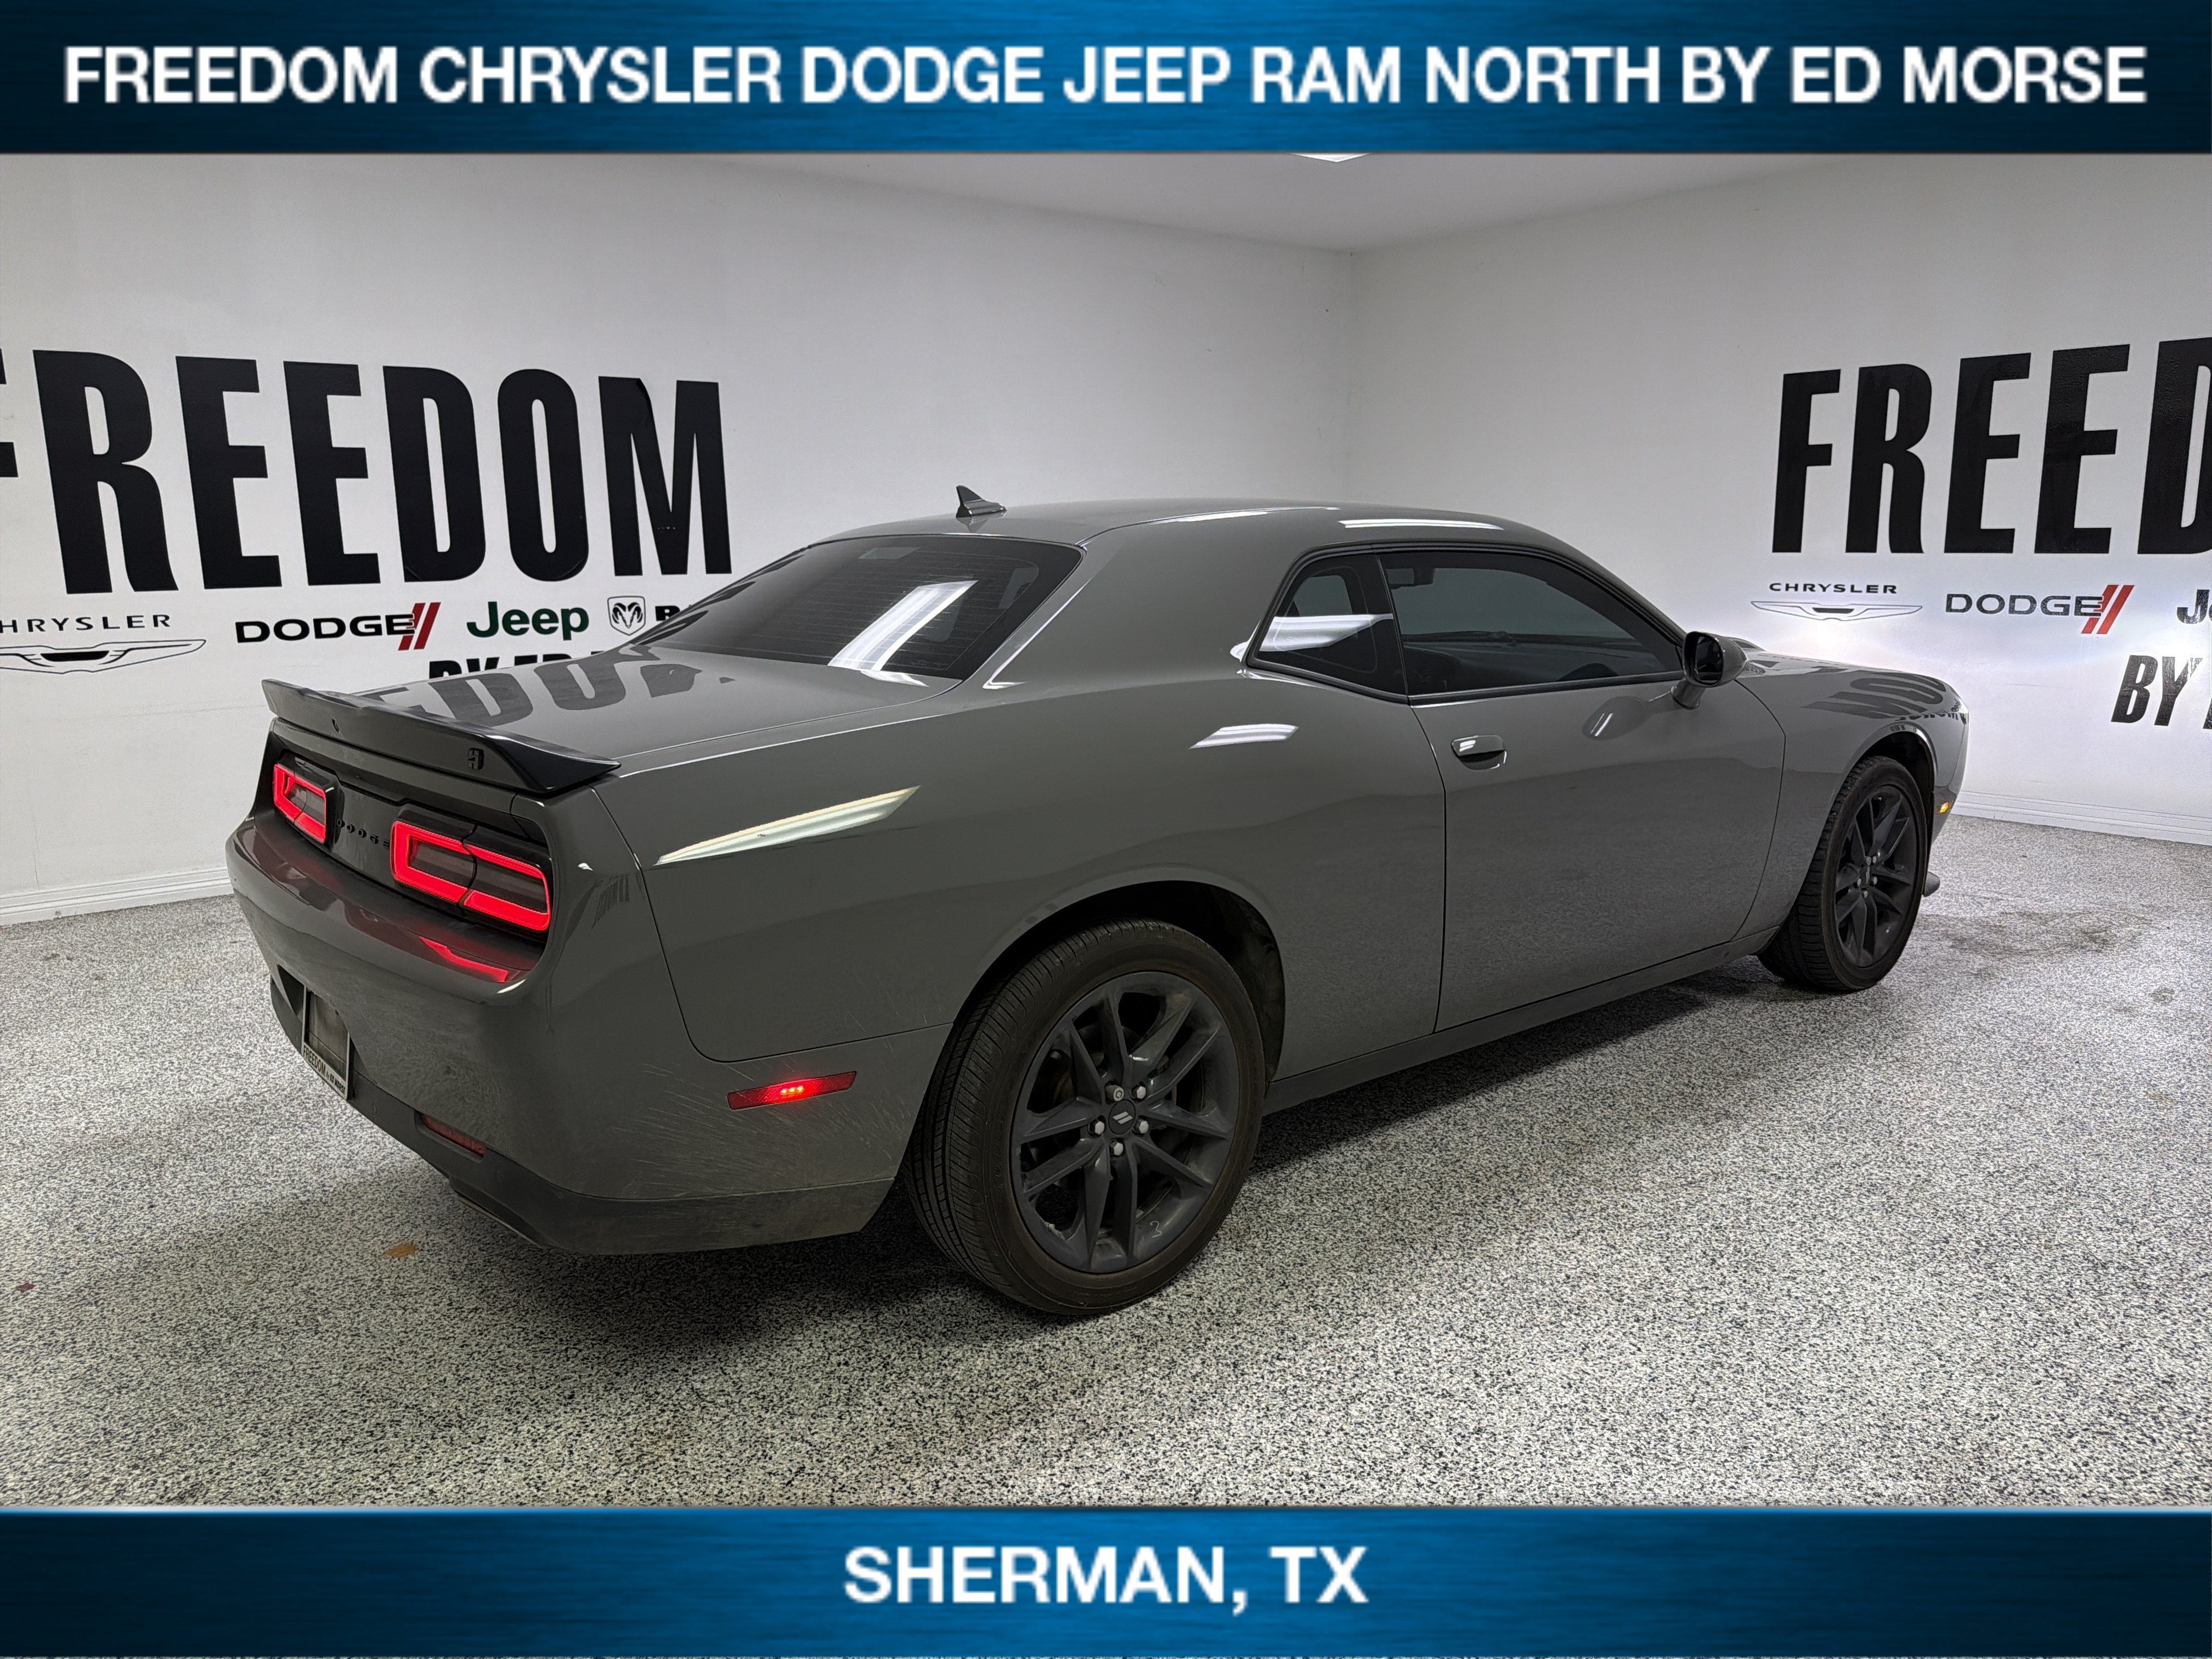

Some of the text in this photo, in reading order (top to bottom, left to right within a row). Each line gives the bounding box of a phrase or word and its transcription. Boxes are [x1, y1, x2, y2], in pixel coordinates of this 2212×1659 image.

[0, 348, 732, 595] REEDOM
[1769, 582, 1898, 595] CHRYSLER
[1945, 593, 2103, 617] DODGE
[235, 613, 415, 644] DODGE
[466, 601, 590, 641] Jeep
[2110, 654, 2203, 727] BY
[303, 1044, 326, 1077] FREEDOM
